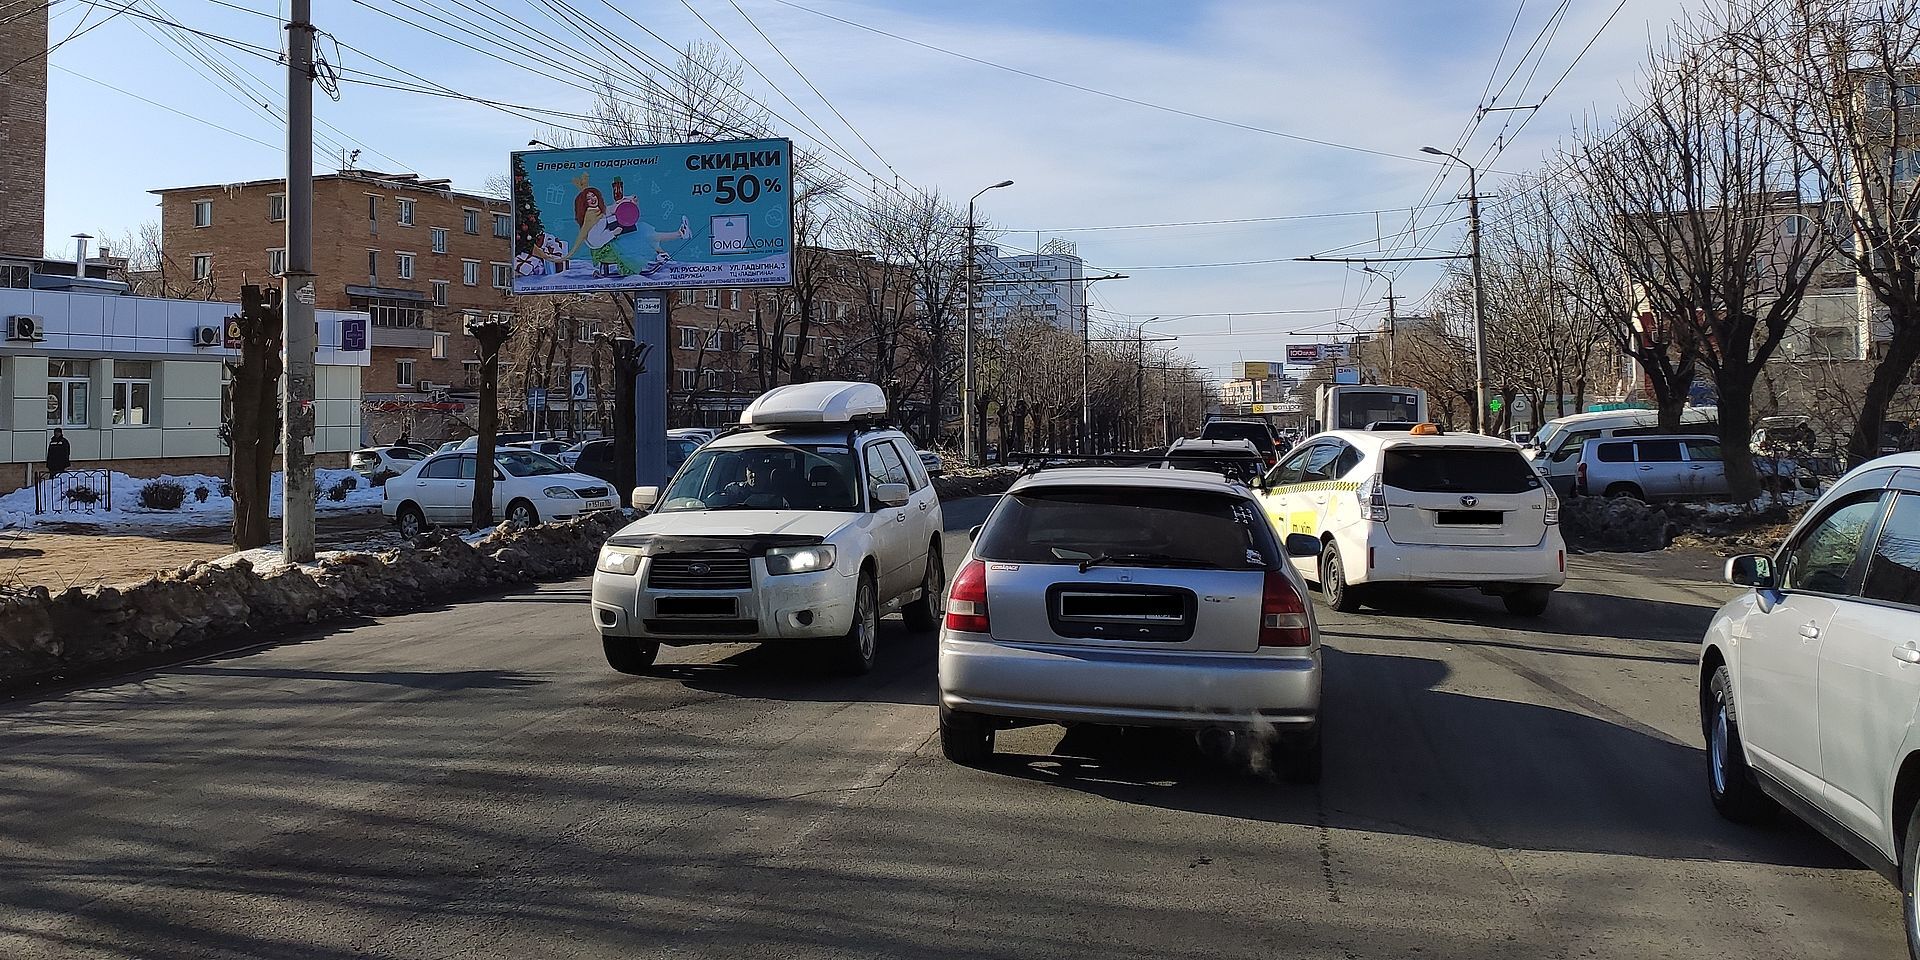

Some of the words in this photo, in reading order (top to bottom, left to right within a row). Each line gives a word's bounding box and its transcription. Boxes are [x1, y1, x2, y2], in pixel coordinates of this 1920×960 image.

[536, 161, 576, 171] Вперёд
[578, 161, 591, 169] за
[593, 155, 660, 168] подарками!
[685, 151, 781, 171] СКИДКИ
[692, 183, 712, 196] до
[714, 174, 761, 205] 50
[764, 177, 782, 193] %
